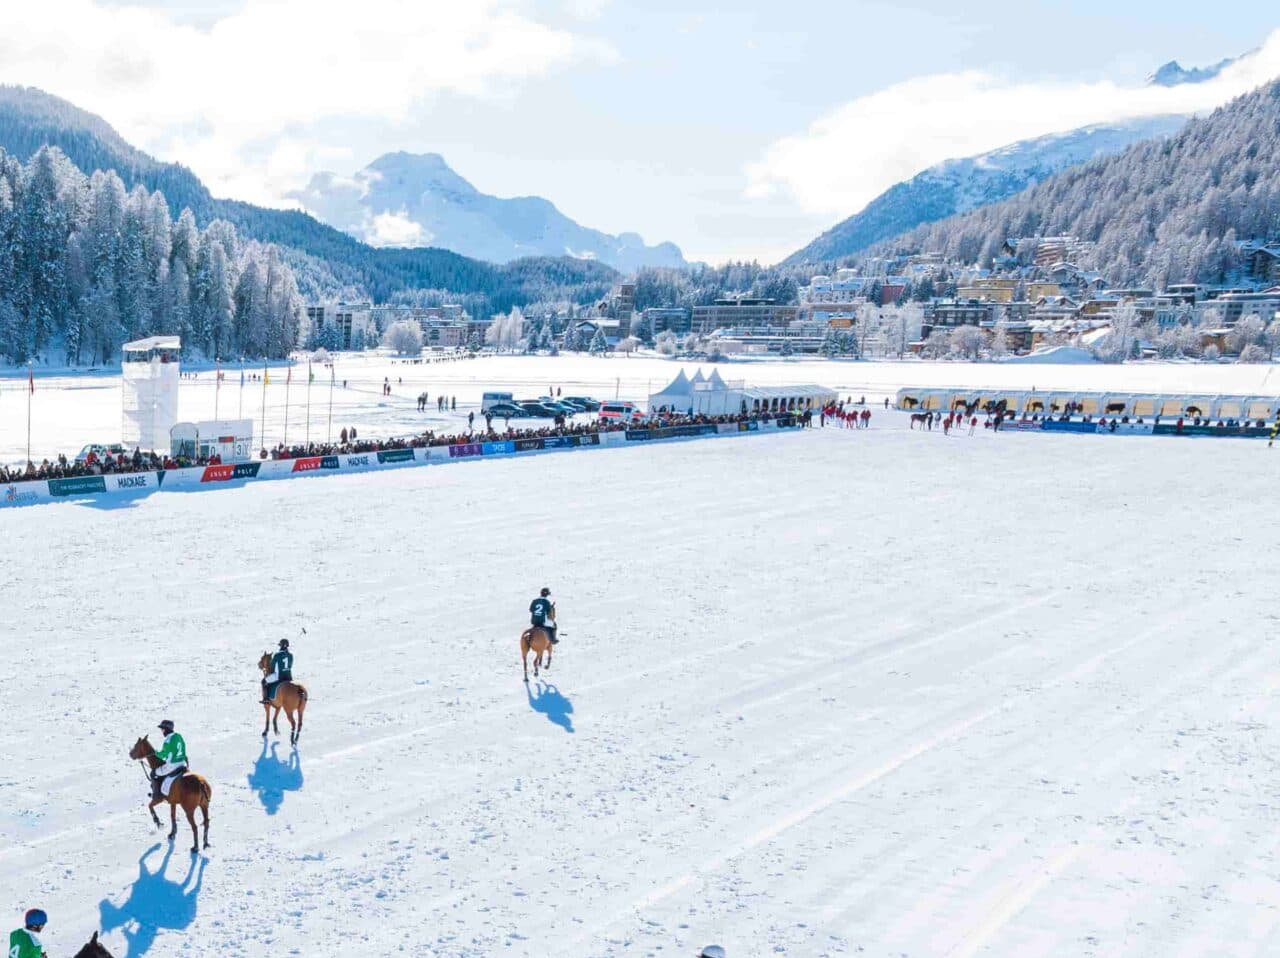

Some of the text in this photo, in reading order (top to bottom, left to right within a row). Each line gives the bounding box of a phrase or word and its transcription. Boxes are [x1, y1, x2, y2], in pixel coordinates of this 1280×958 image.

[535, 604, 543, 614] 2
[282, 657, 288, 668] 1
[176, 742, 182, 756] 2
